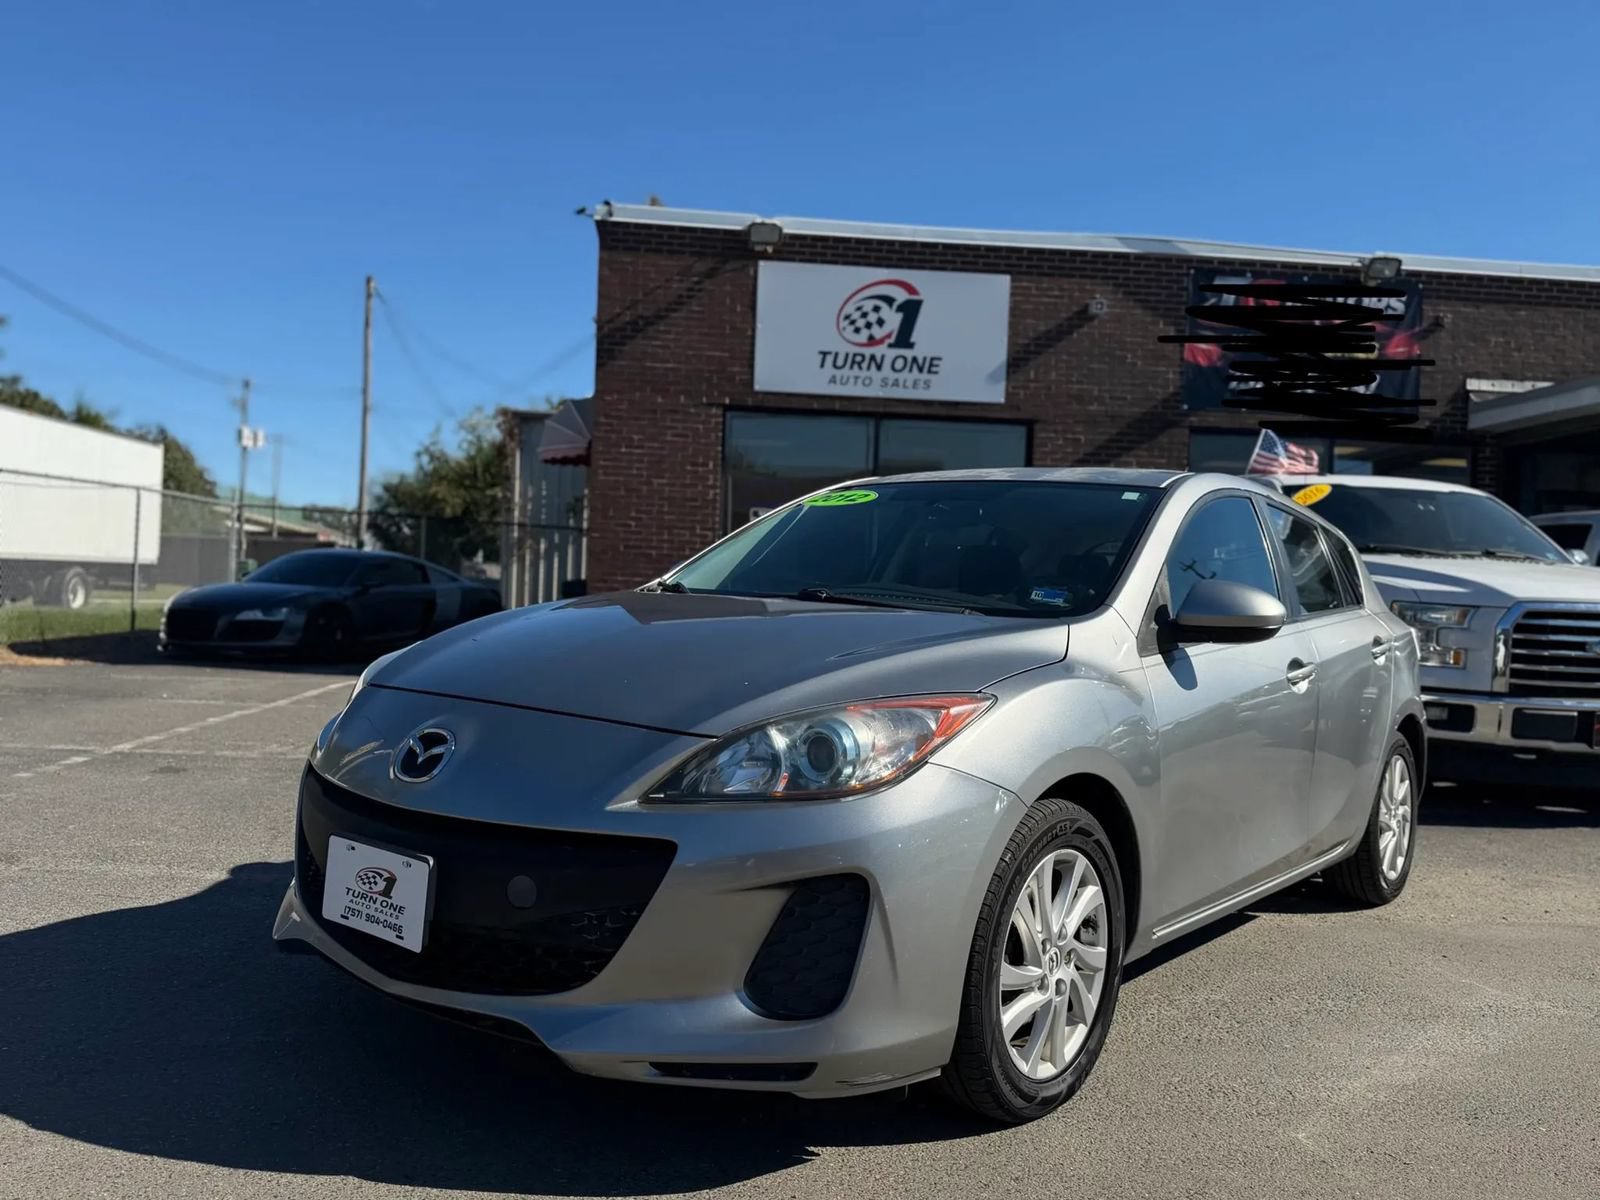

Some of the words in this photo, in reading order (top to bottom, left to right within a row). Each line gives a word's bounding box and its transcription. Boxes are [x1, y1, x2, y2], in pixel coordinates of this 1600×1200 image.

[887, 298, 924, 350] 1
[818, 351, 885, 372] TURN
[891, 355, 942, 375] ONE
[828, 374, 873, 388] AUTO
[880, 377, 932, 390] SALES
[381, 877, 397, 899] 1
[345, 887, 377, 905] TURN
[380, 898, 406, 915] ONE
[349, 898, 371, 910] AUTO
[374, 907, 399, 920] SALES
[343, 905, 363, 920] (757)
[364, 912, 404, 934] 904-0466
